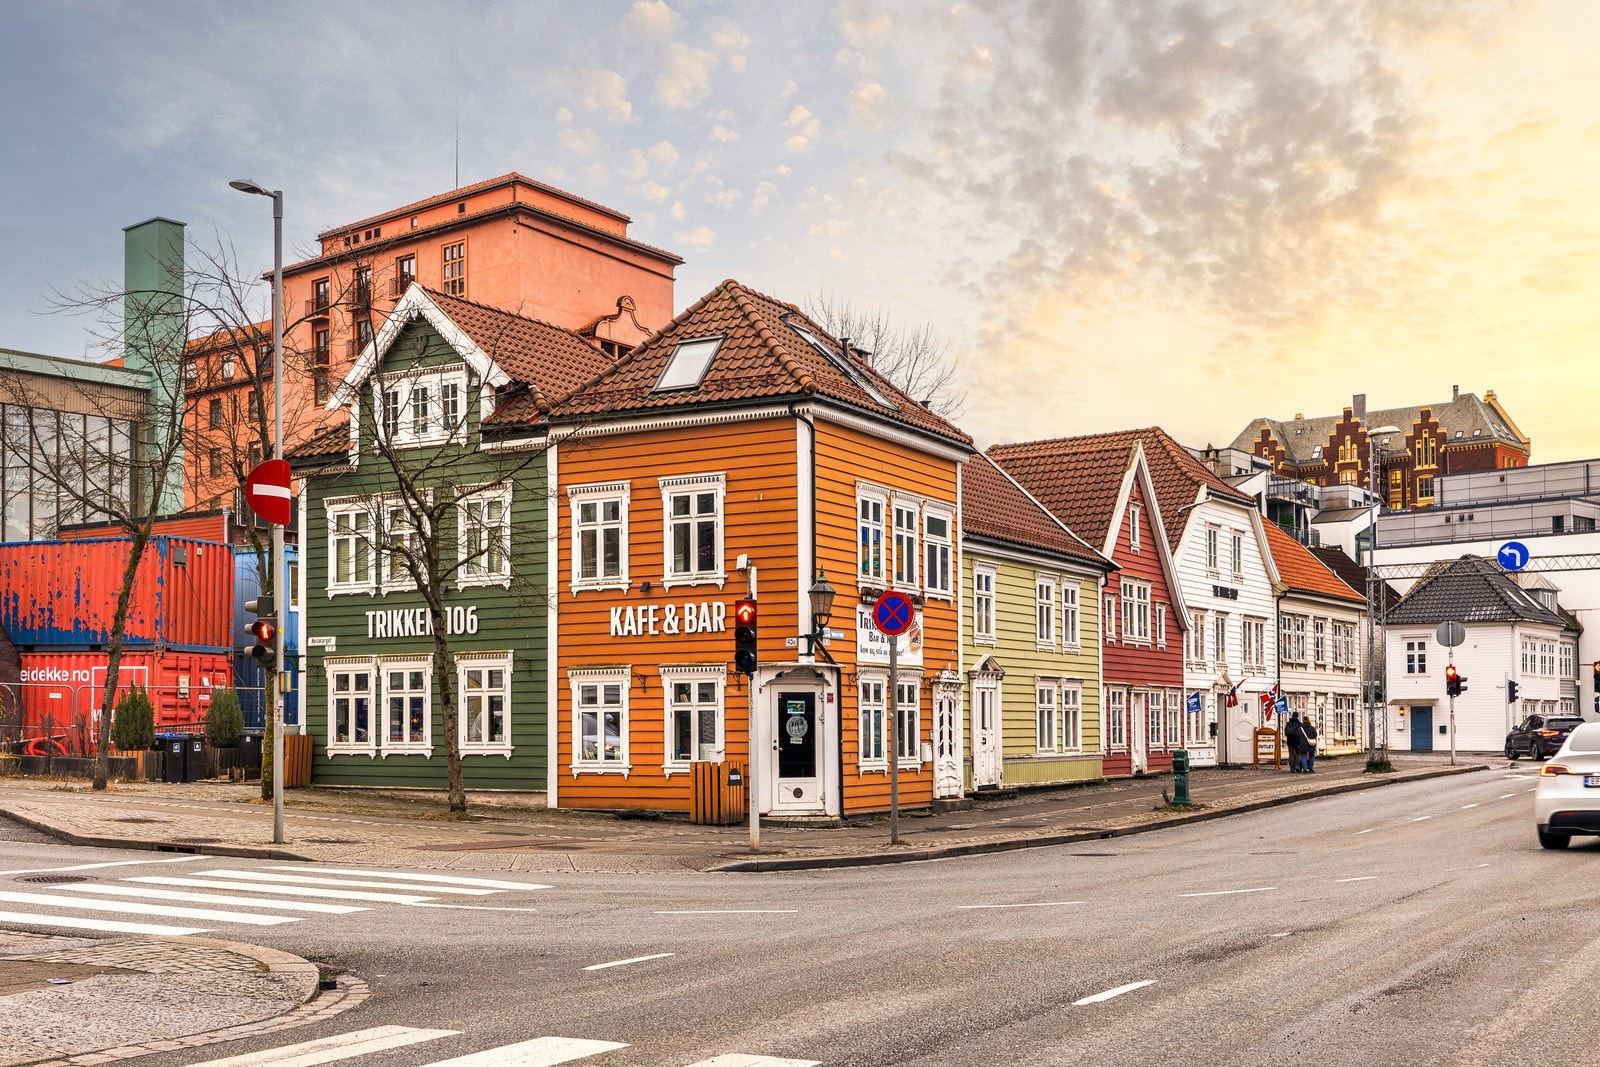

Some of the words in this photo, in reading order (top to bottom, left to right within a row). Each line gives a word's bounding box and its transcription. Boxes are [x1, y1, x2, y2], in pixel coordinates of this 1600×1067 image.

[365, 608, 435, 638] TRIKKEN
[445, 606, 478, 635] 106
[610, 606, 659, 636] KAFE
[663, 604, 680, 634] &
[684, 602, 726, 633] BAR
[20, 666, 90, 682] eidekke.no
